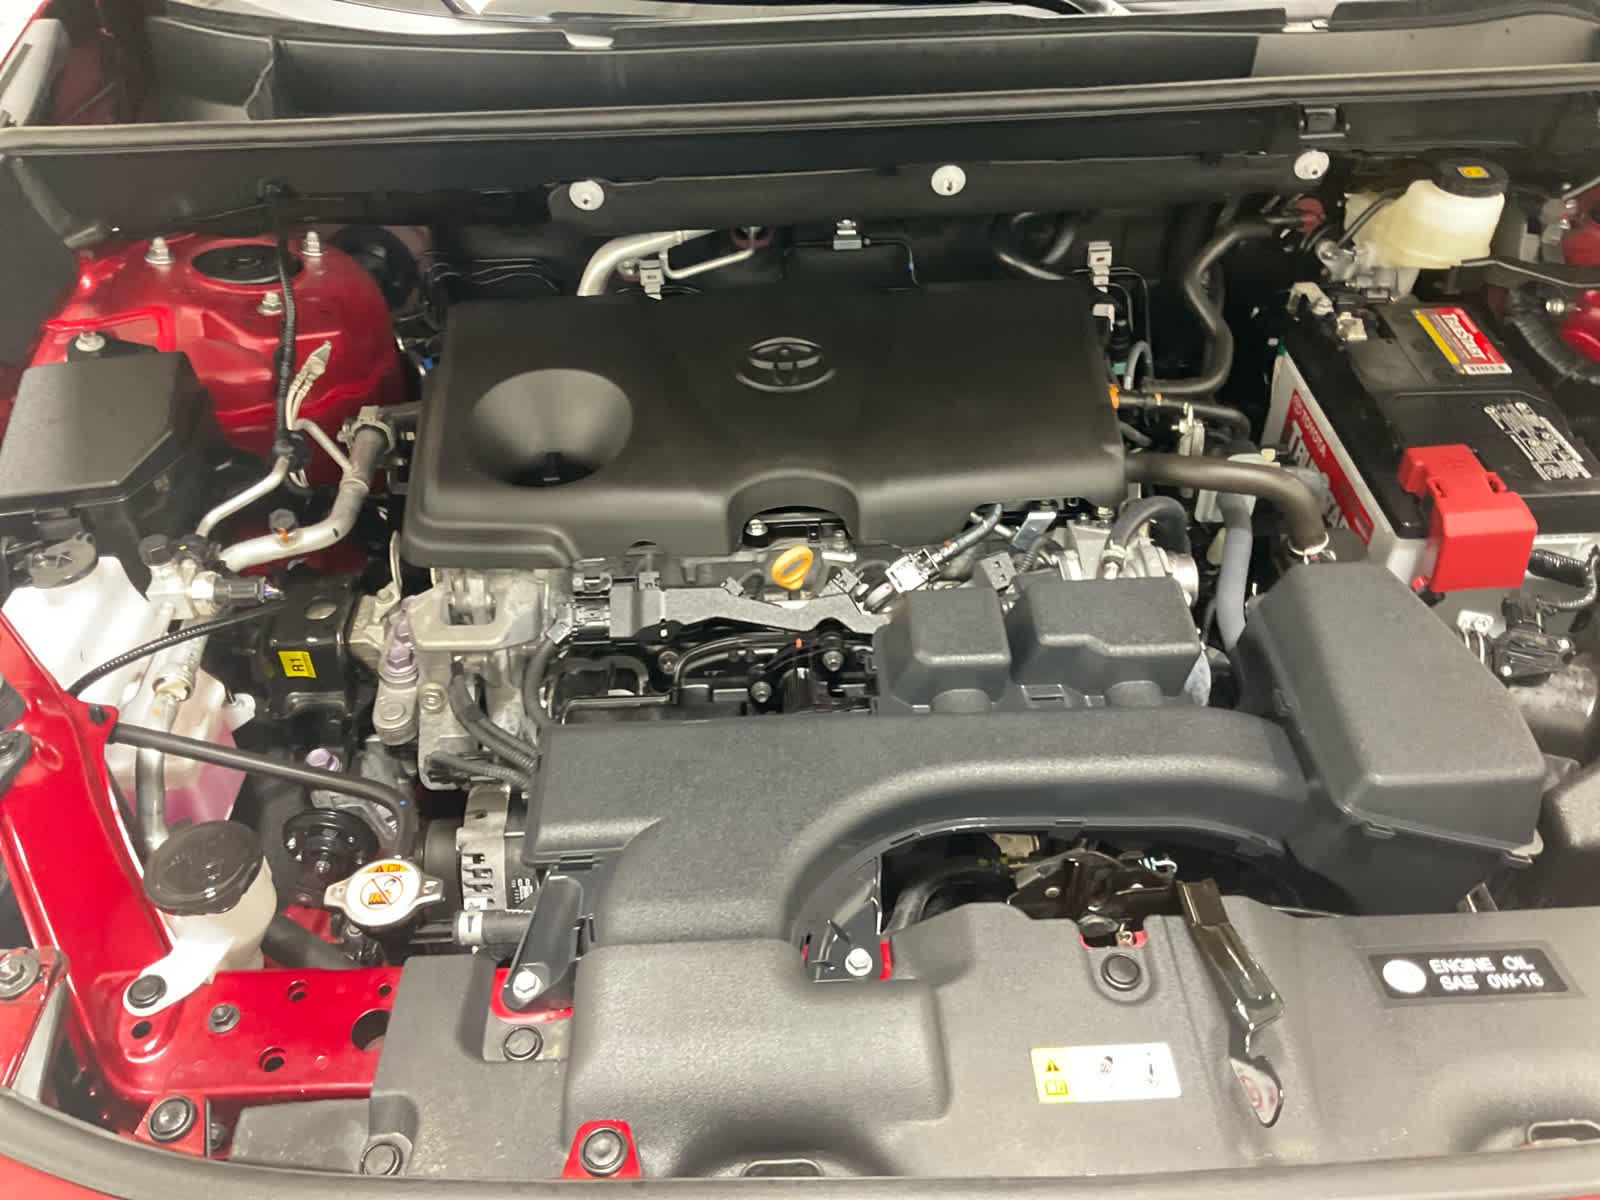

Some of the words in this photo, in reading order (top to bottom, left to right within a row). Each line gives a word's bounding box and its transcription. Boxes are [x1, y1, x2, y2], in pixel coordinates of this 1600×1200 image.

[1301, 413, 1326, 458] TOYOTA
[1429, 957, 1496, 974] ENGINE
[1502, 955, 1535, 971] OIL
[1439, 975, 1479, 991] SAE
[1486, 972, 1544, 989] 0W-16
